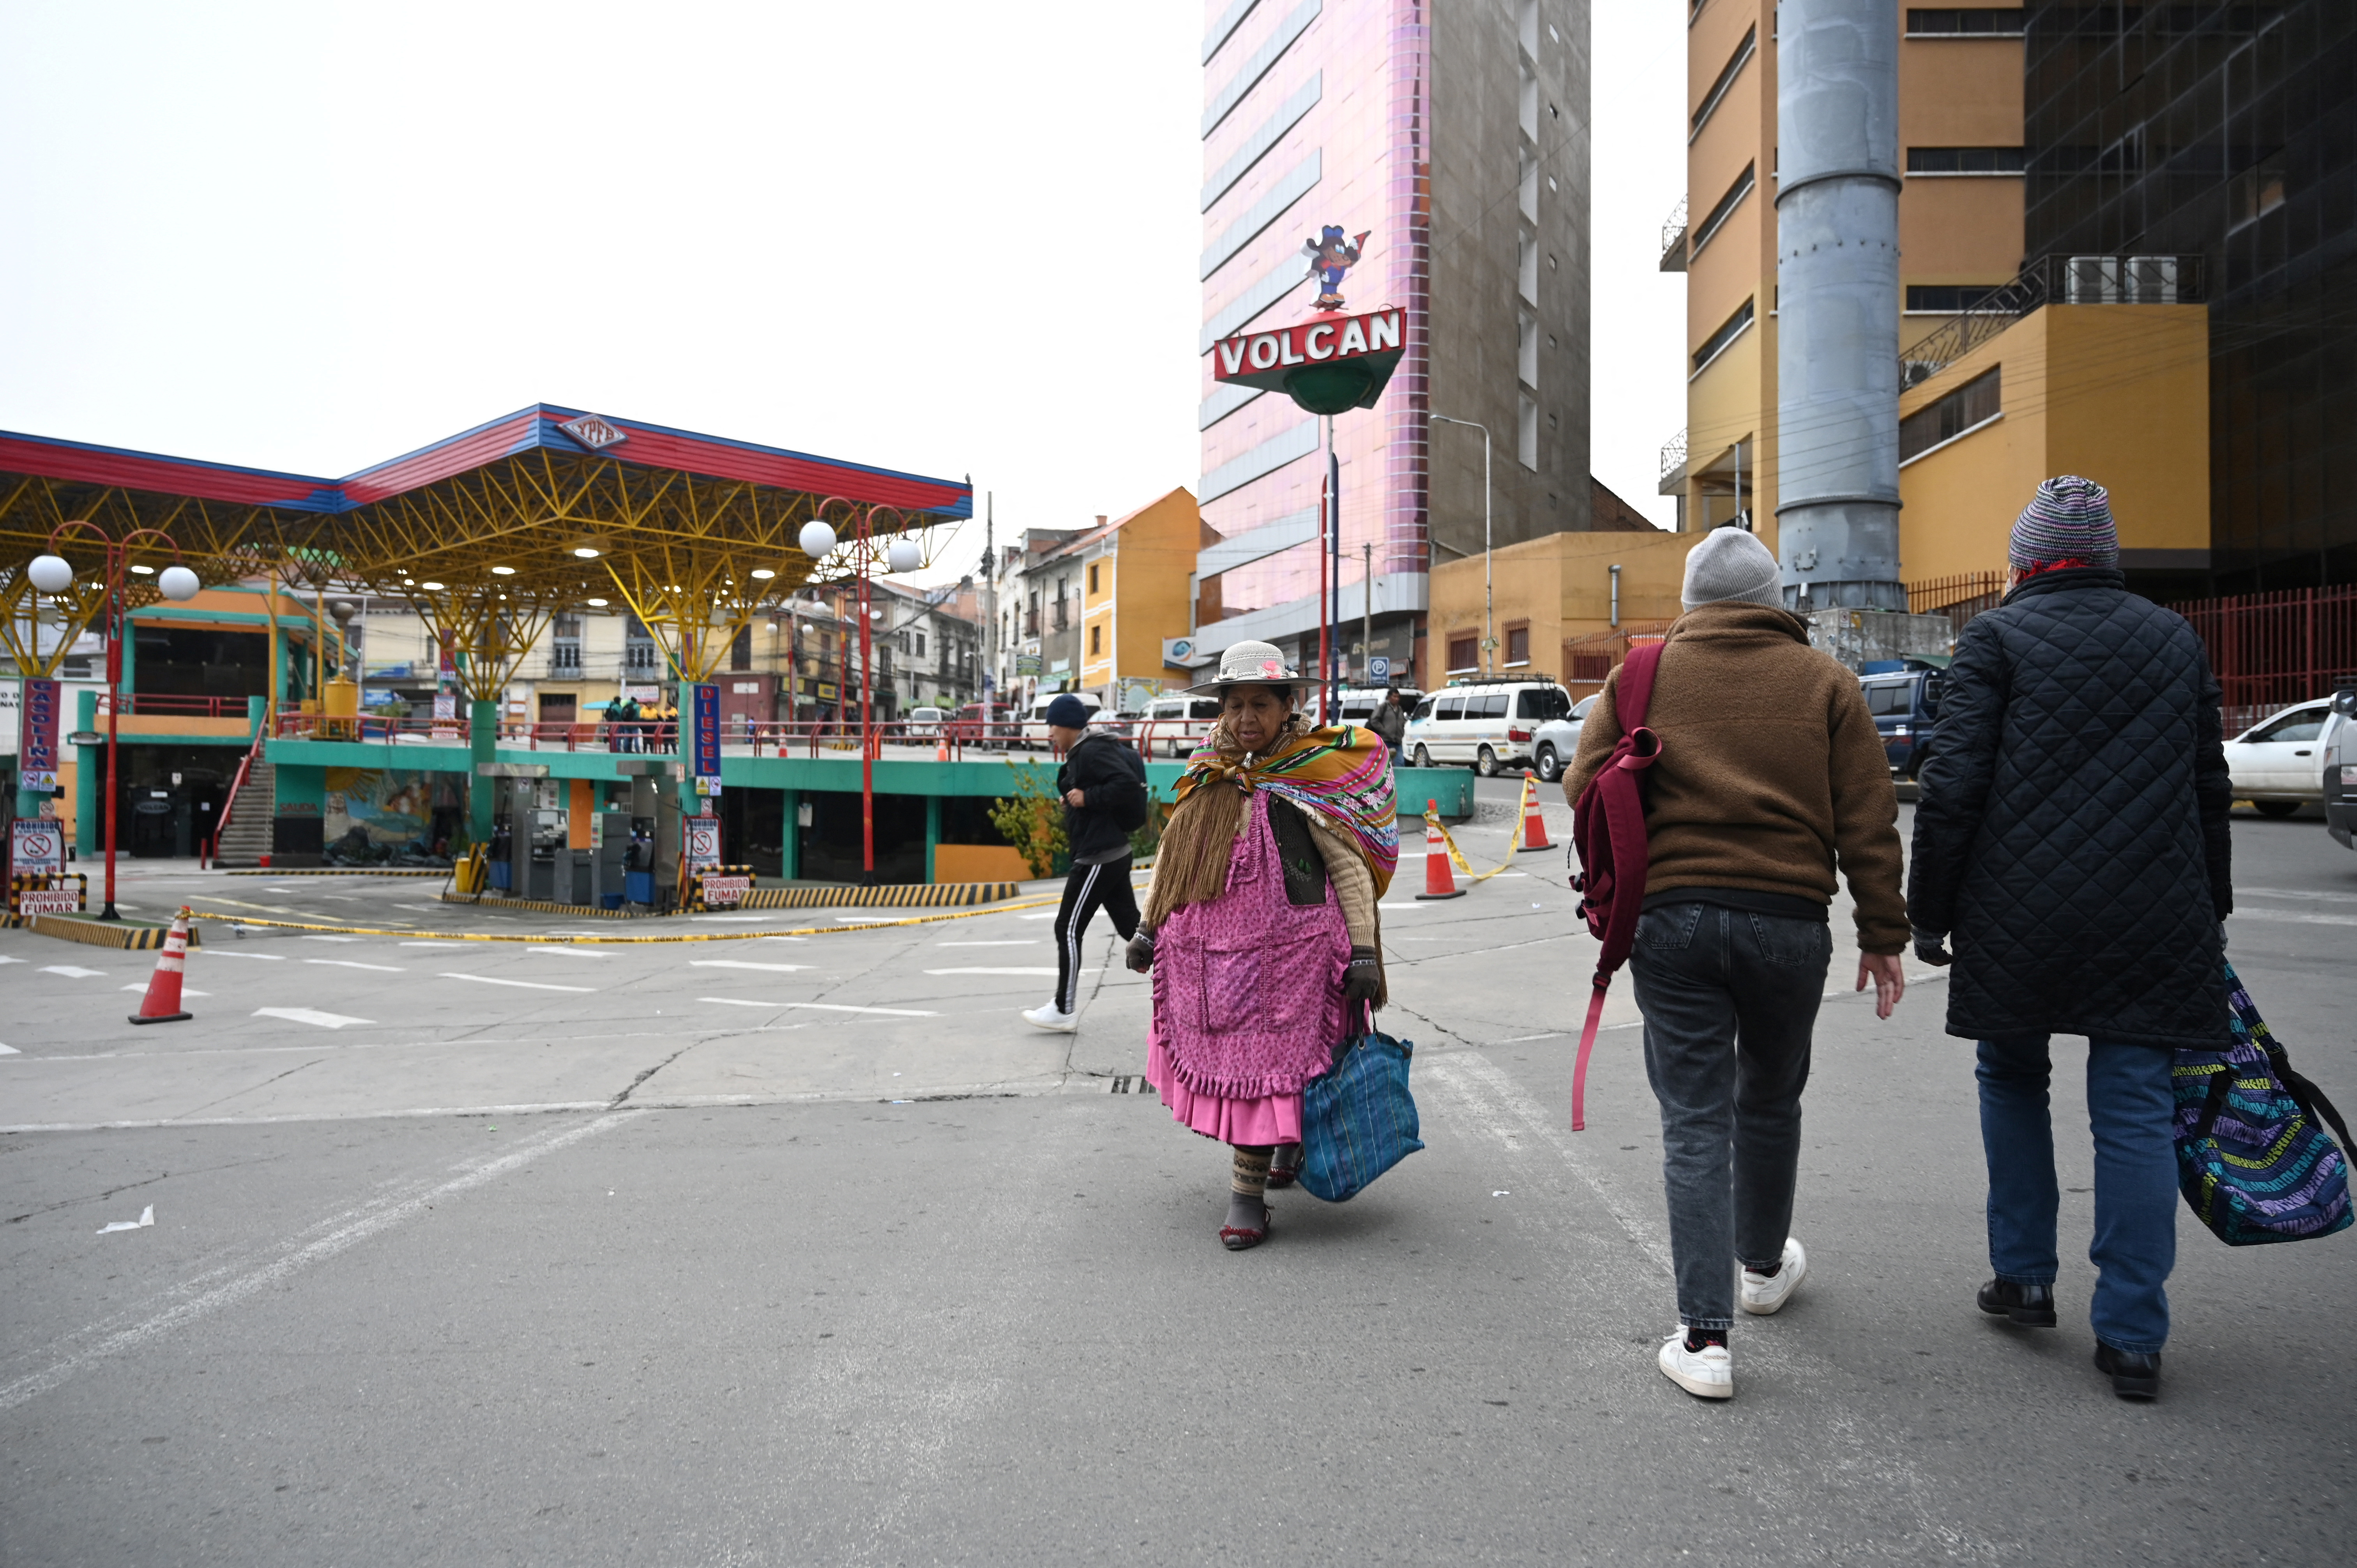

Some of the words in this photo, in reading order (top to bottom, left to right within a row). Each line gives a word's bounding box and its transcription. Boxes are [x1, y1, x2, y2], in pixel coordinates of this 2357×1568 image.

[1218, 311, 1400, 375] VOLCAN
[578, 420, 615, 443] YPFB
[26, 682, 53, 770] GASOLINA
[701, 687, 715, 773] DIESEL
[279, 803, 318, 812] SALIDA
[15, 821, 58, 829] PROHIBIDO
[705, 879, 748, 889] PROHIBIDO
[21, 892, 78, 903] PROHIBIDO
[708, 890, 739, 901] FUMA
[25, 904, 73, 913] FUMAR
